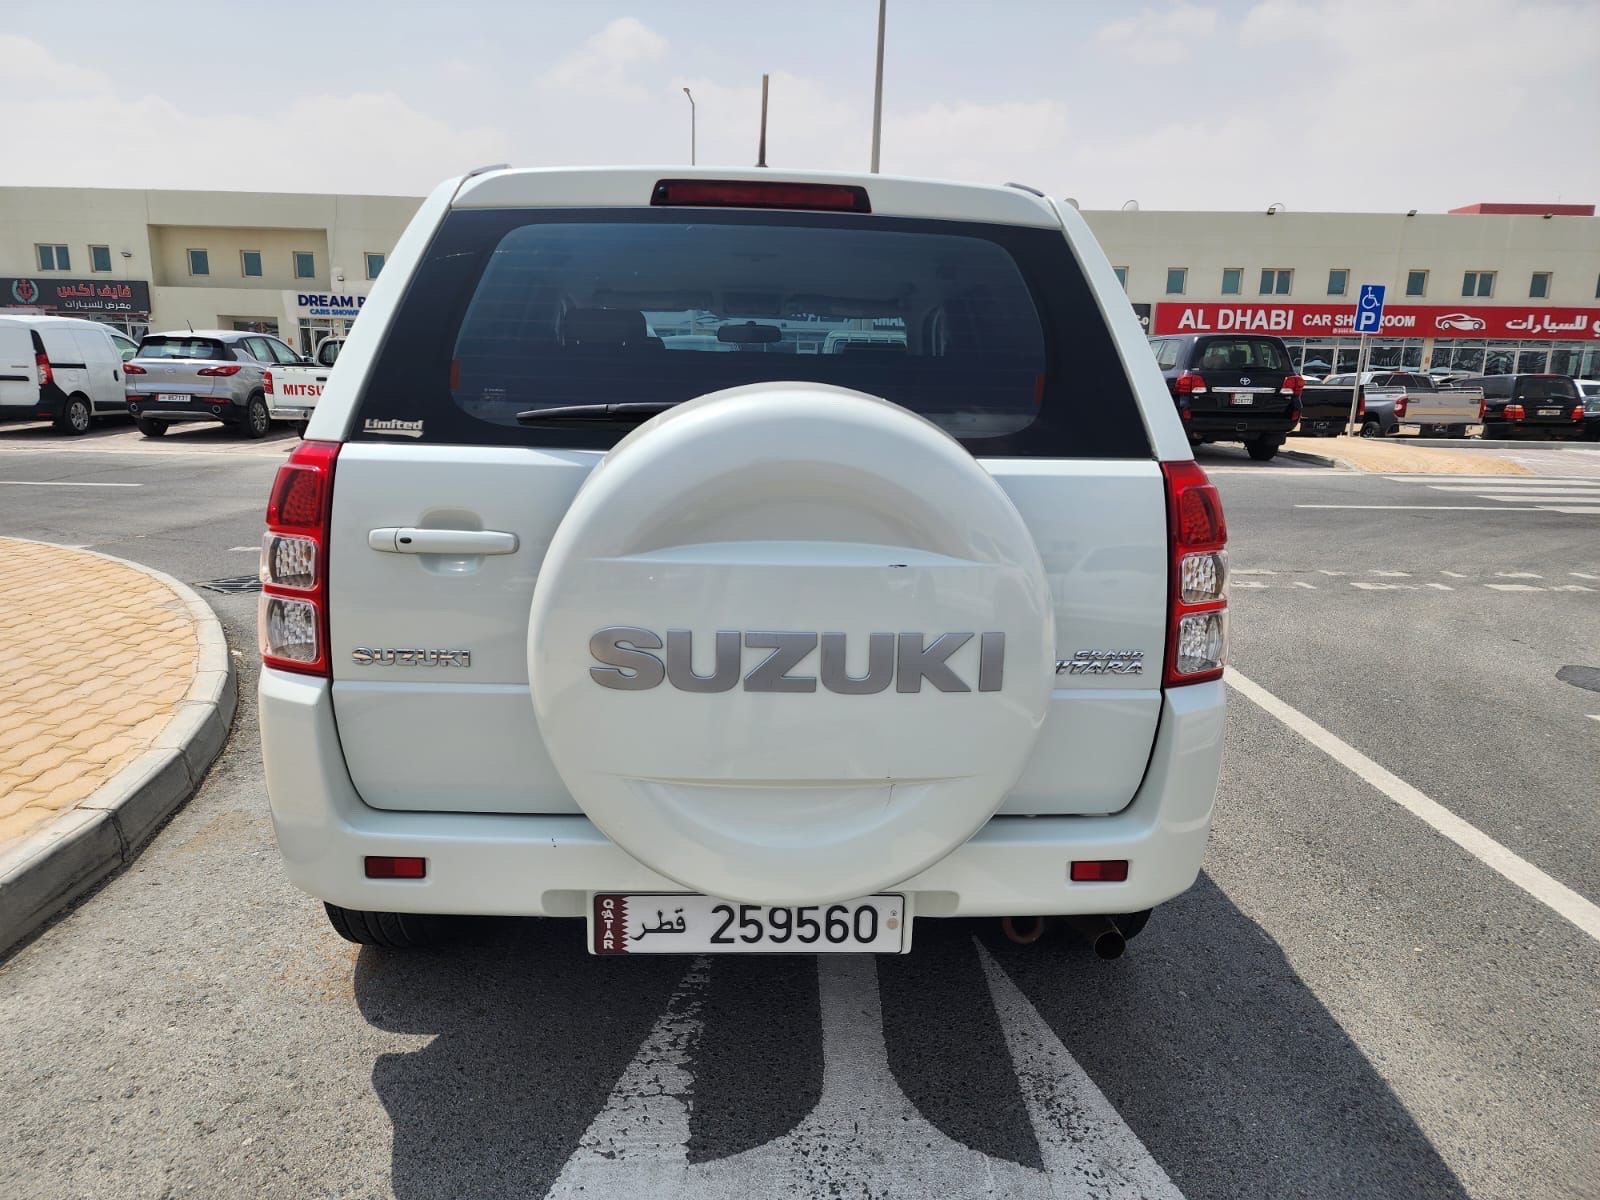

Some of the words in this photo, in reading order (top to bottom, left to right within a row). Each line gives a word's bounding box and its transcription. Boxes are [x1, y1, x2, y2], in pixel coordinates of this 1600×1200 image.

[65, 300, 103, 310] للسيارات
[104, 301, 132, 310] معرض
[298, 294, 354, 308] DREAM
[310, 308, 331, 316] CARS
[1176, 308, 1212, 330] AL
[1216, 308, 1295, 331] DHABI
[1302, 314, 1332, 327] CAR
[1360, 311, 1376, 331] P
[1505, 314, 1589, 335] للسيارات
[364, 417, 424, 431] Limited
[352, 647, 471, 668] SUZUKI
[588, 626, 1006, 694] SUZUKI
[1074, 649, 1145, 660] GRAND
[601, 898, 615, 950] QATAR
[629, 908, 687, 941] قطر
[710, 904, 879, 944] 259560
